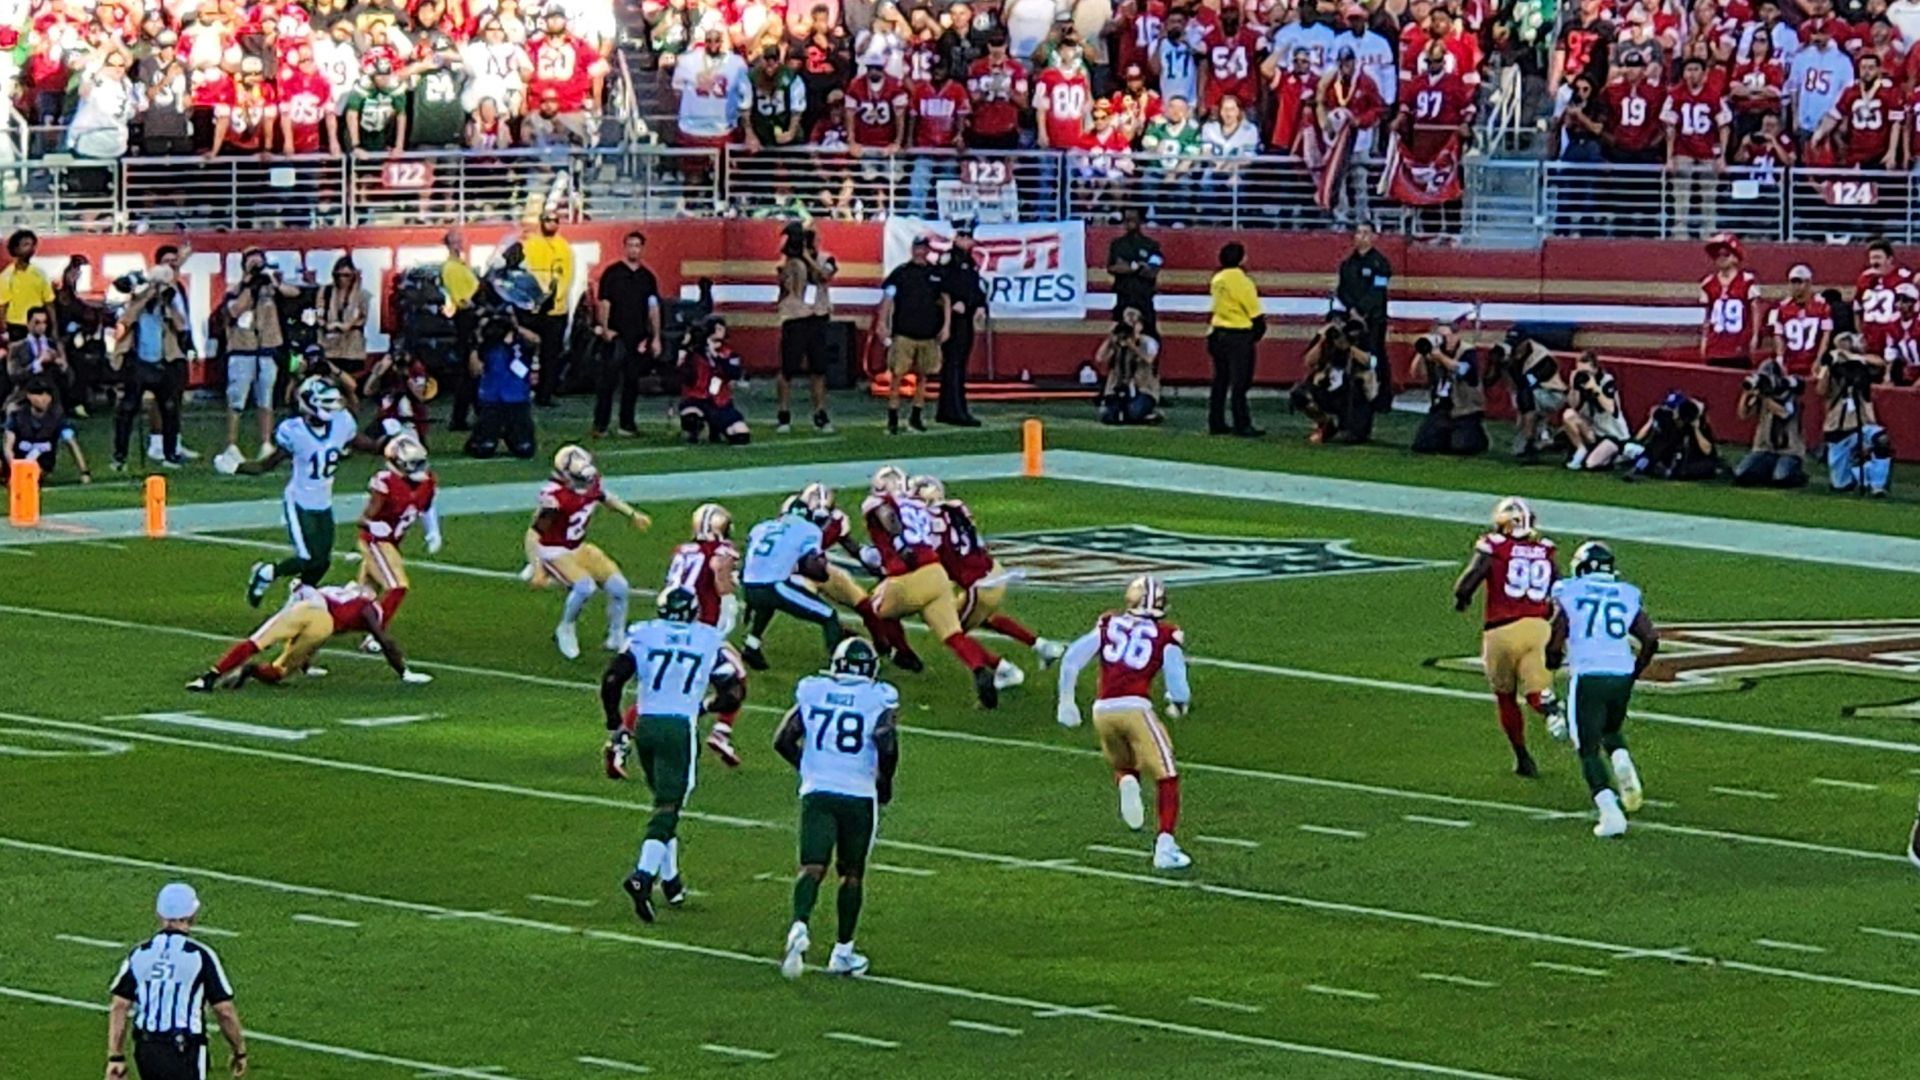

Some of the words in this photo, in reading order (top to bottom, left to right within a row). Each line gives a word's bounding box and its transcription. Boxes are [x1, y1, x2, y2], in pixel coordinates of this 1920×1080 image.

[1165, 52, 1190, 79] 17
[1212, 46, 1248, 79] 54
[1805, 67, 1832, 95] 85
[1053, 83, 1085, 119] 80
[1416, 91, 1442, 118] 97
[1621, 97, 1647, 126] 19
[1681, 103, 1711, 135] 16
[390, 164, 427, 186] 122
[968, 160, 1006, 184] 123
[1832, 181, 1872, 205] 124
[1711, 298, 1744, 333] 49
[1862, 288, 1897, 324] 23
[1784, 321, 1819, 351] 97
[754, 530, 785, 557] 5
[667, 552, 705, 592] 97
[1504, 557, 1552, 602] 99
[1575, 597, 1628, 639] 76
[1102, 616, 1158, 670] 56
[647, 647, 704, 695] 77
[808, 705, 864, 755] 78
[151, 961, 176, 980] 51
